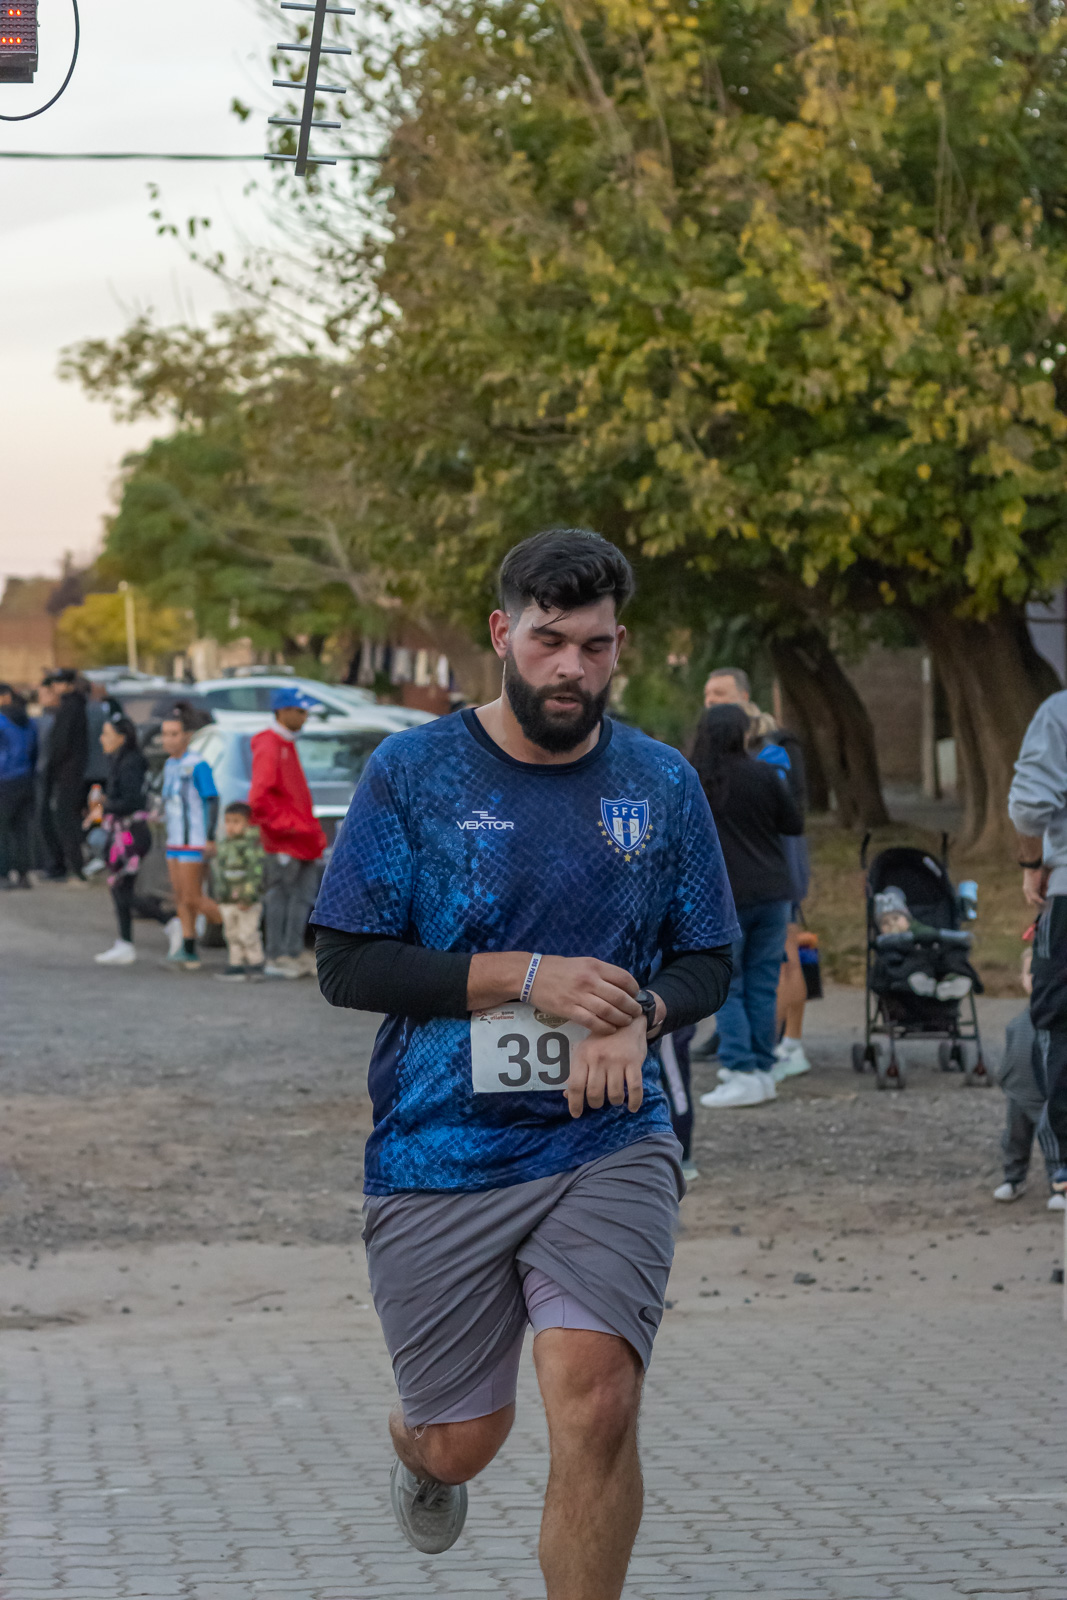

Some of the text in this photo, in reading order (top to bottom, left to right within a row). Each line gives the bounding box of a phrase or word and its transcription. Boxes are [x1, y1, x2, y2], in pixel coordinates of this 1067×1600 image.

[612, 806, 639, 817] SFC
[456, 820, 515, 830] VEKTOR
[497, 1031, 570, 1087] 39
